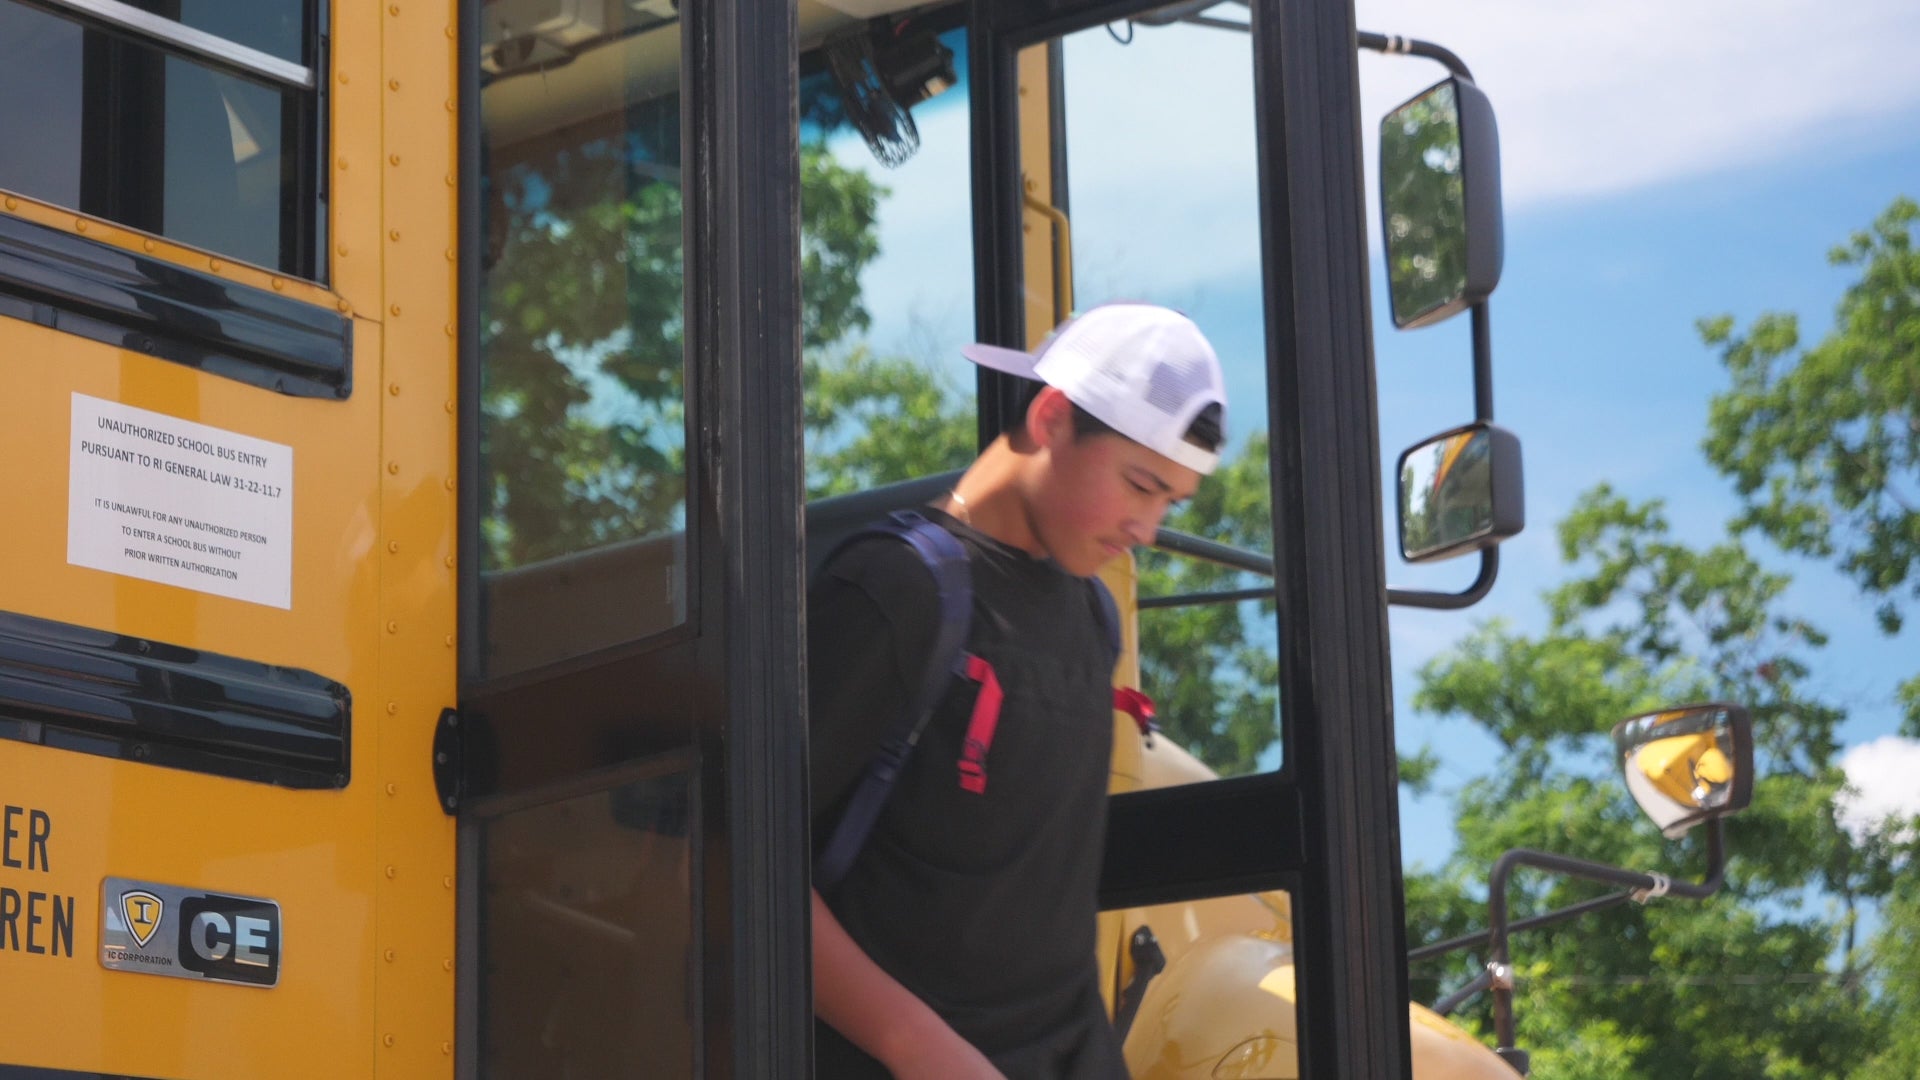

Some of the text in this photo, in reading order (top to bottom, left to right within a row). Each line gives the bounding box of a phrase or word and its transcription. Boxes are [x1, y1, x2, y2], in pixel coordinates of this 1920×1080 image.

[97, 416, 268, 468] UNAUTHORIZED SCHOOL BUS ENTRY
[81, 440, 282, 499] PURSUANT TO RI GENERAL LAW 31-22-11.7
[94, 498, 267, 545] IT IS UNLAWFUL FOR ANY UNAUTHORIZED PERSON
[122, 525, 241, 560] TO ENTER A SCHOOL BUS WITHOUT
[124, 548, 238, 580] PRIOR WRITTEN AUTHORIZATION
[2, 804, 51, 873] ER
[0, 886, 75, 958] REN
[190, 911, 271, 968] CE
[107, 950, 173, 966] IC CORPORATION
